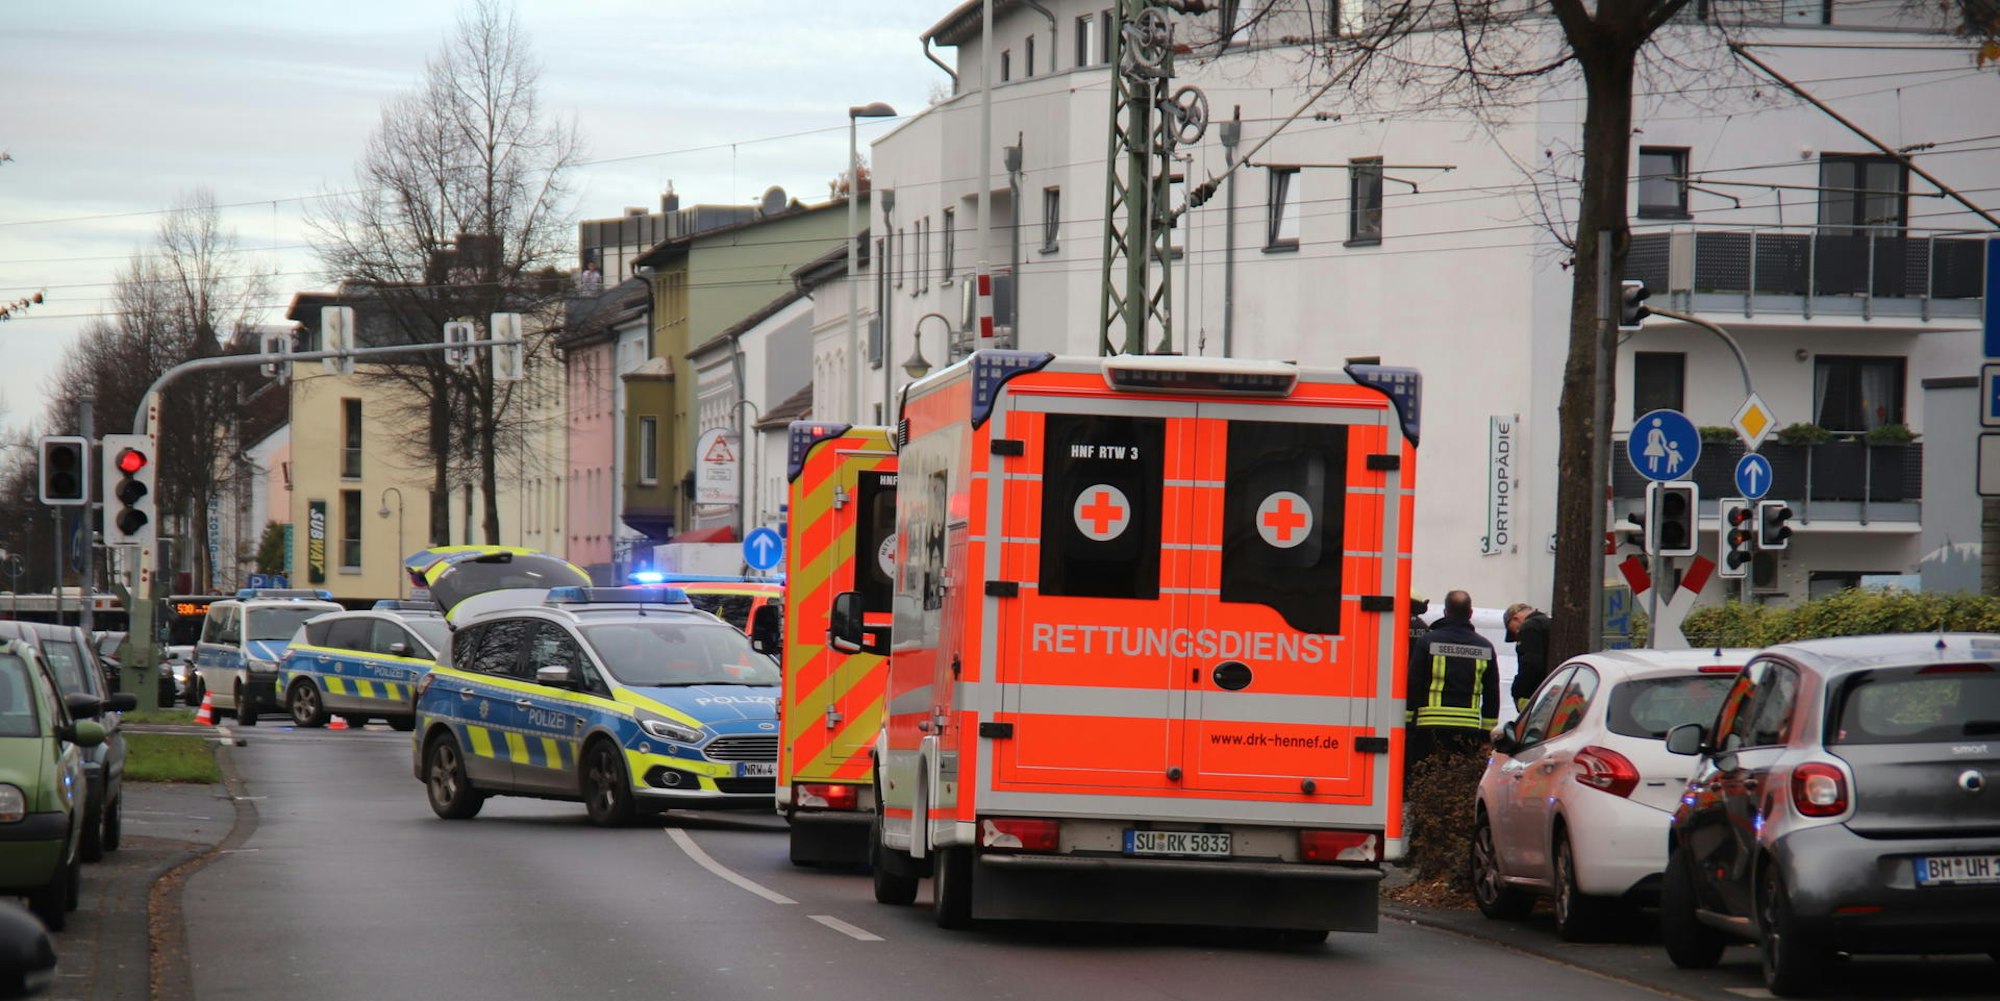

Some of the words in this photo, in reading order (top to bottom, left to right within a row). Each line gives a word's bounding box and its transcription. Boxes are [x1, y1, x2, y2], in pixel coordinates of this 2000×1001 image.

[1071, 445, 1094, 459] HNF
[1099, 446, 1126, 460] RTW
[1130, 447, 1139, 460] 3
[1495, 422, 1510, 545] ORTHOPÄDIE
[310, 508, 324, 575] SUBWAY
[1032, 623, 1345, 664] RETTUNGSDIENST
[1438, 645, 1483, 656] SEELSORGER
[374, 666, 404, 678] POLIZEI
[527, 707, 567, 730] POLIZEI
[1211, 733, 1340, 750] www.drk-hennef.de
[1952, 744, 1988, 755] smart
[744, 764, 763, 776] NRW
[1136, 833, 1156, 851] SU
[1167, 834, 1187, 852] RK
[1190, 835, 1230, 853] 5833
[1928, 859, 1952, 878] BM
[1965, 858, 1990, 877] UH
